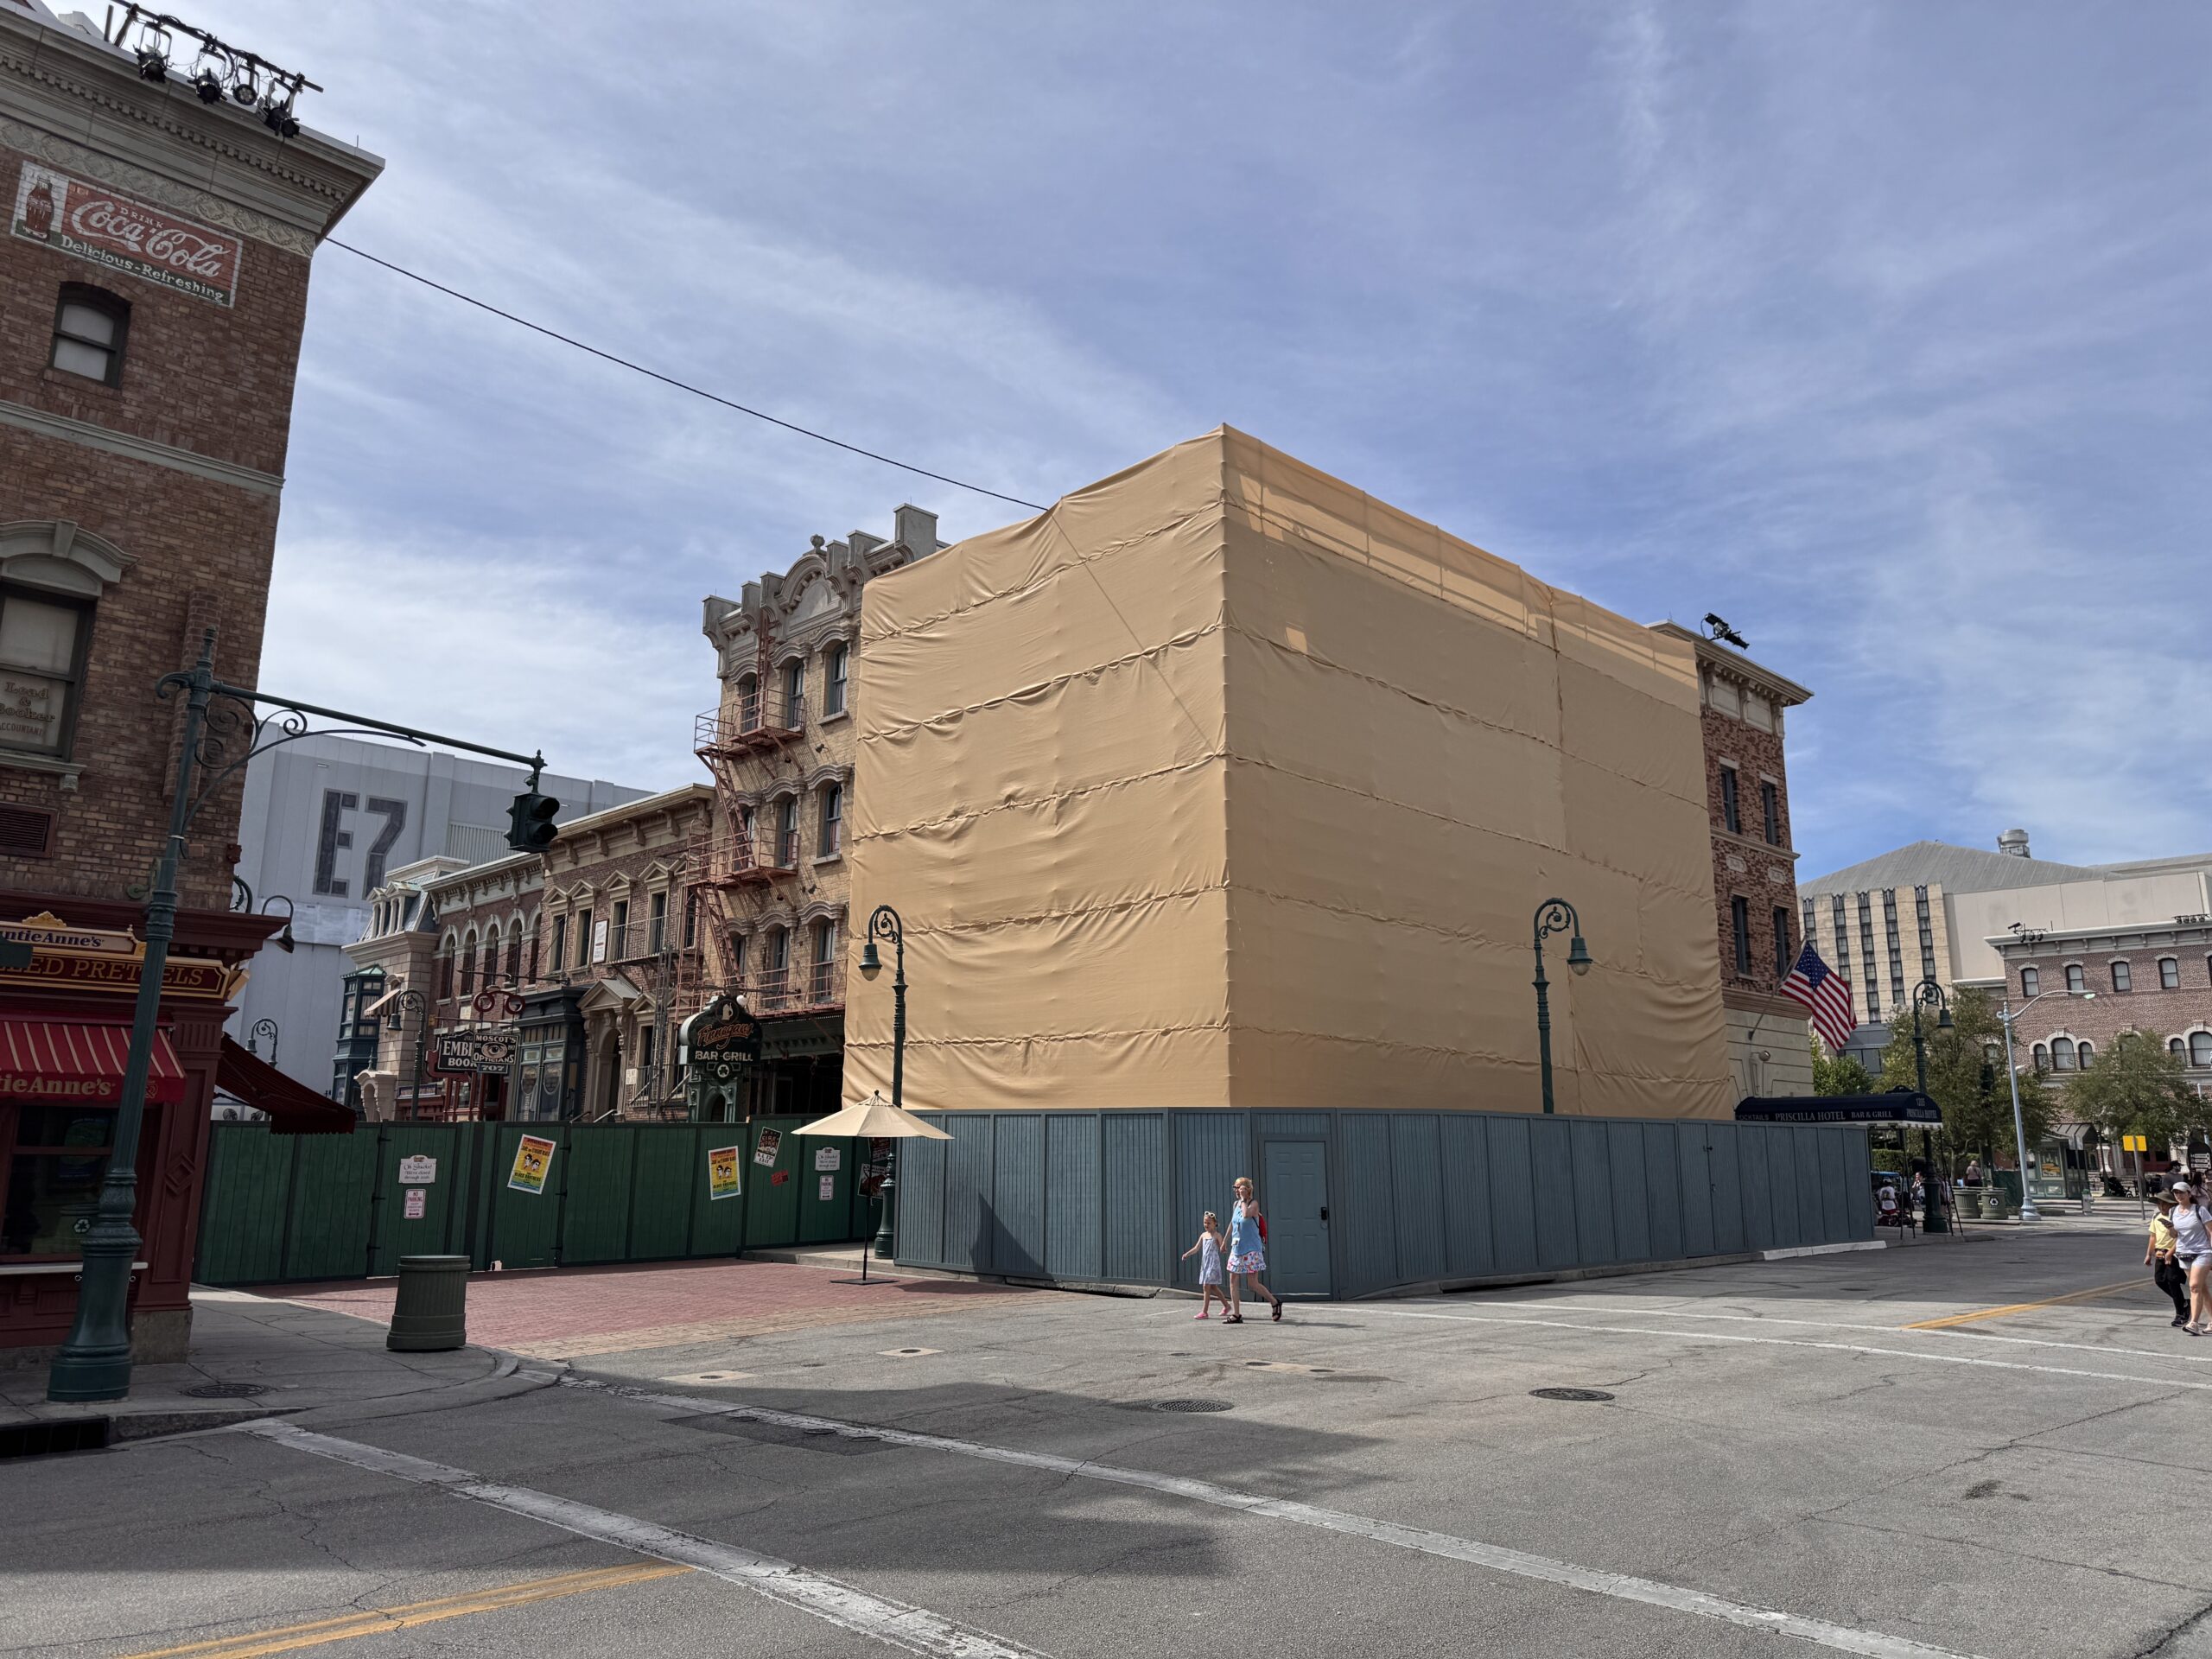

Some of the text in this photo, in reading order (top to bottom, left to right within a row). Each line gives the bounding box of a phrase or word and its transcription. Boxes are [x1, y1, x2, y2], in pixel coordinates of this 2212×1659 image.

[72, 200, 231, 276] Coca-Cola
[19, 696, 31, 707] &
[312, 788, 408, 900] E7
[71, 960, 205, 986] PRETELS
[475, 1034, 517, 1043] MOSCOT'S
[474, 1052, 514, 1063] OPTICIANS
[1775, 1112, 1815, 1122] PRISCILLA
[1817, 1110, 1846, 1121] HOTEL
